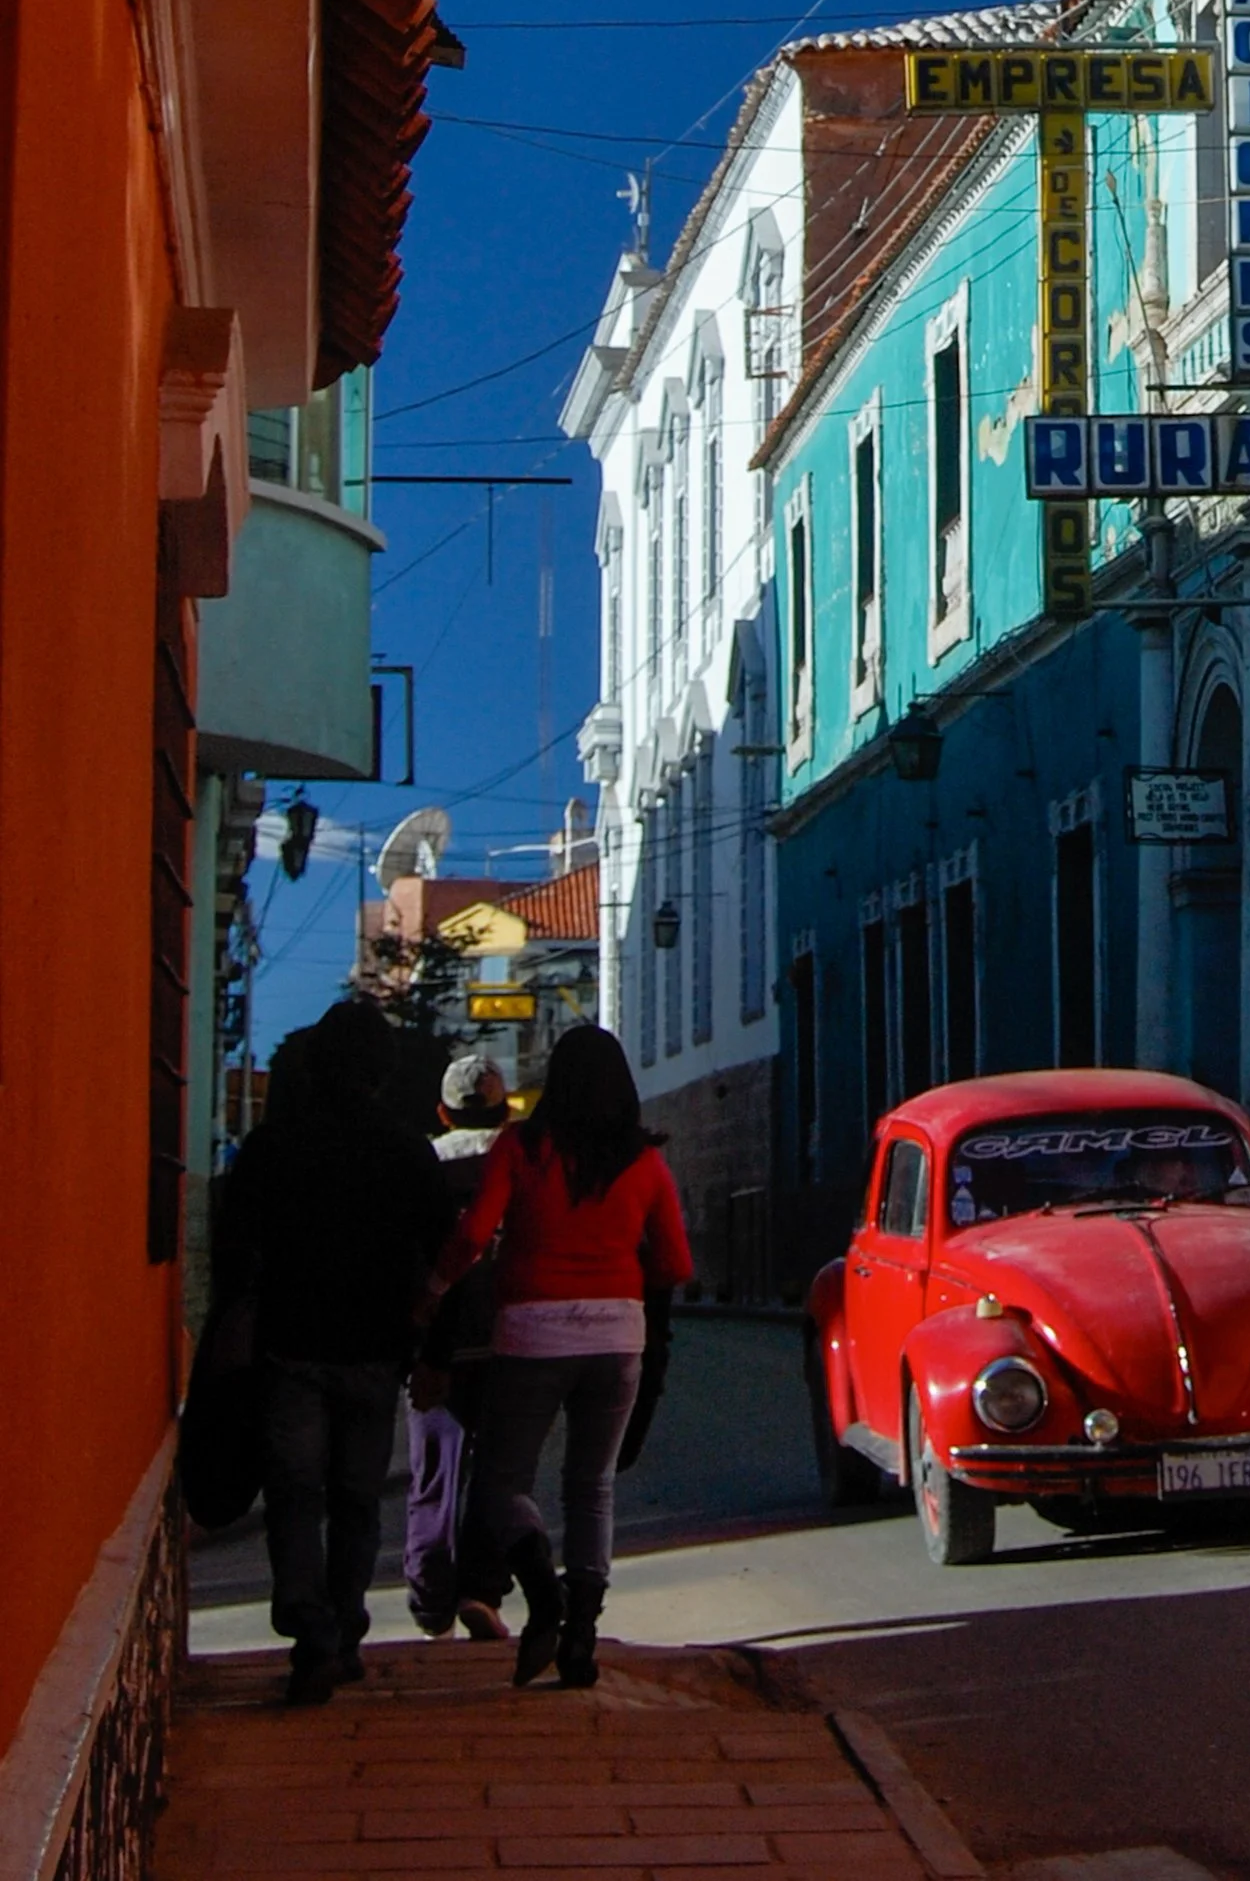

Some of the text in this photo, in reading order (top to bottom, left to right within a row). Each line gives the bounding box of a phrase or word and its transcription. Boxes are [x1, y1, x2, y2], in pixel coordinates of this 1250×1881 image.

[918, 58, 1206, 101] EMPRESA
[1051, 171, 1078, 218] DE
[1048, 230, 1085, 611] COROS
[960, 1126, 1232, 1160] CAMEL
[1168, 1463, 1203, 1490] 196
